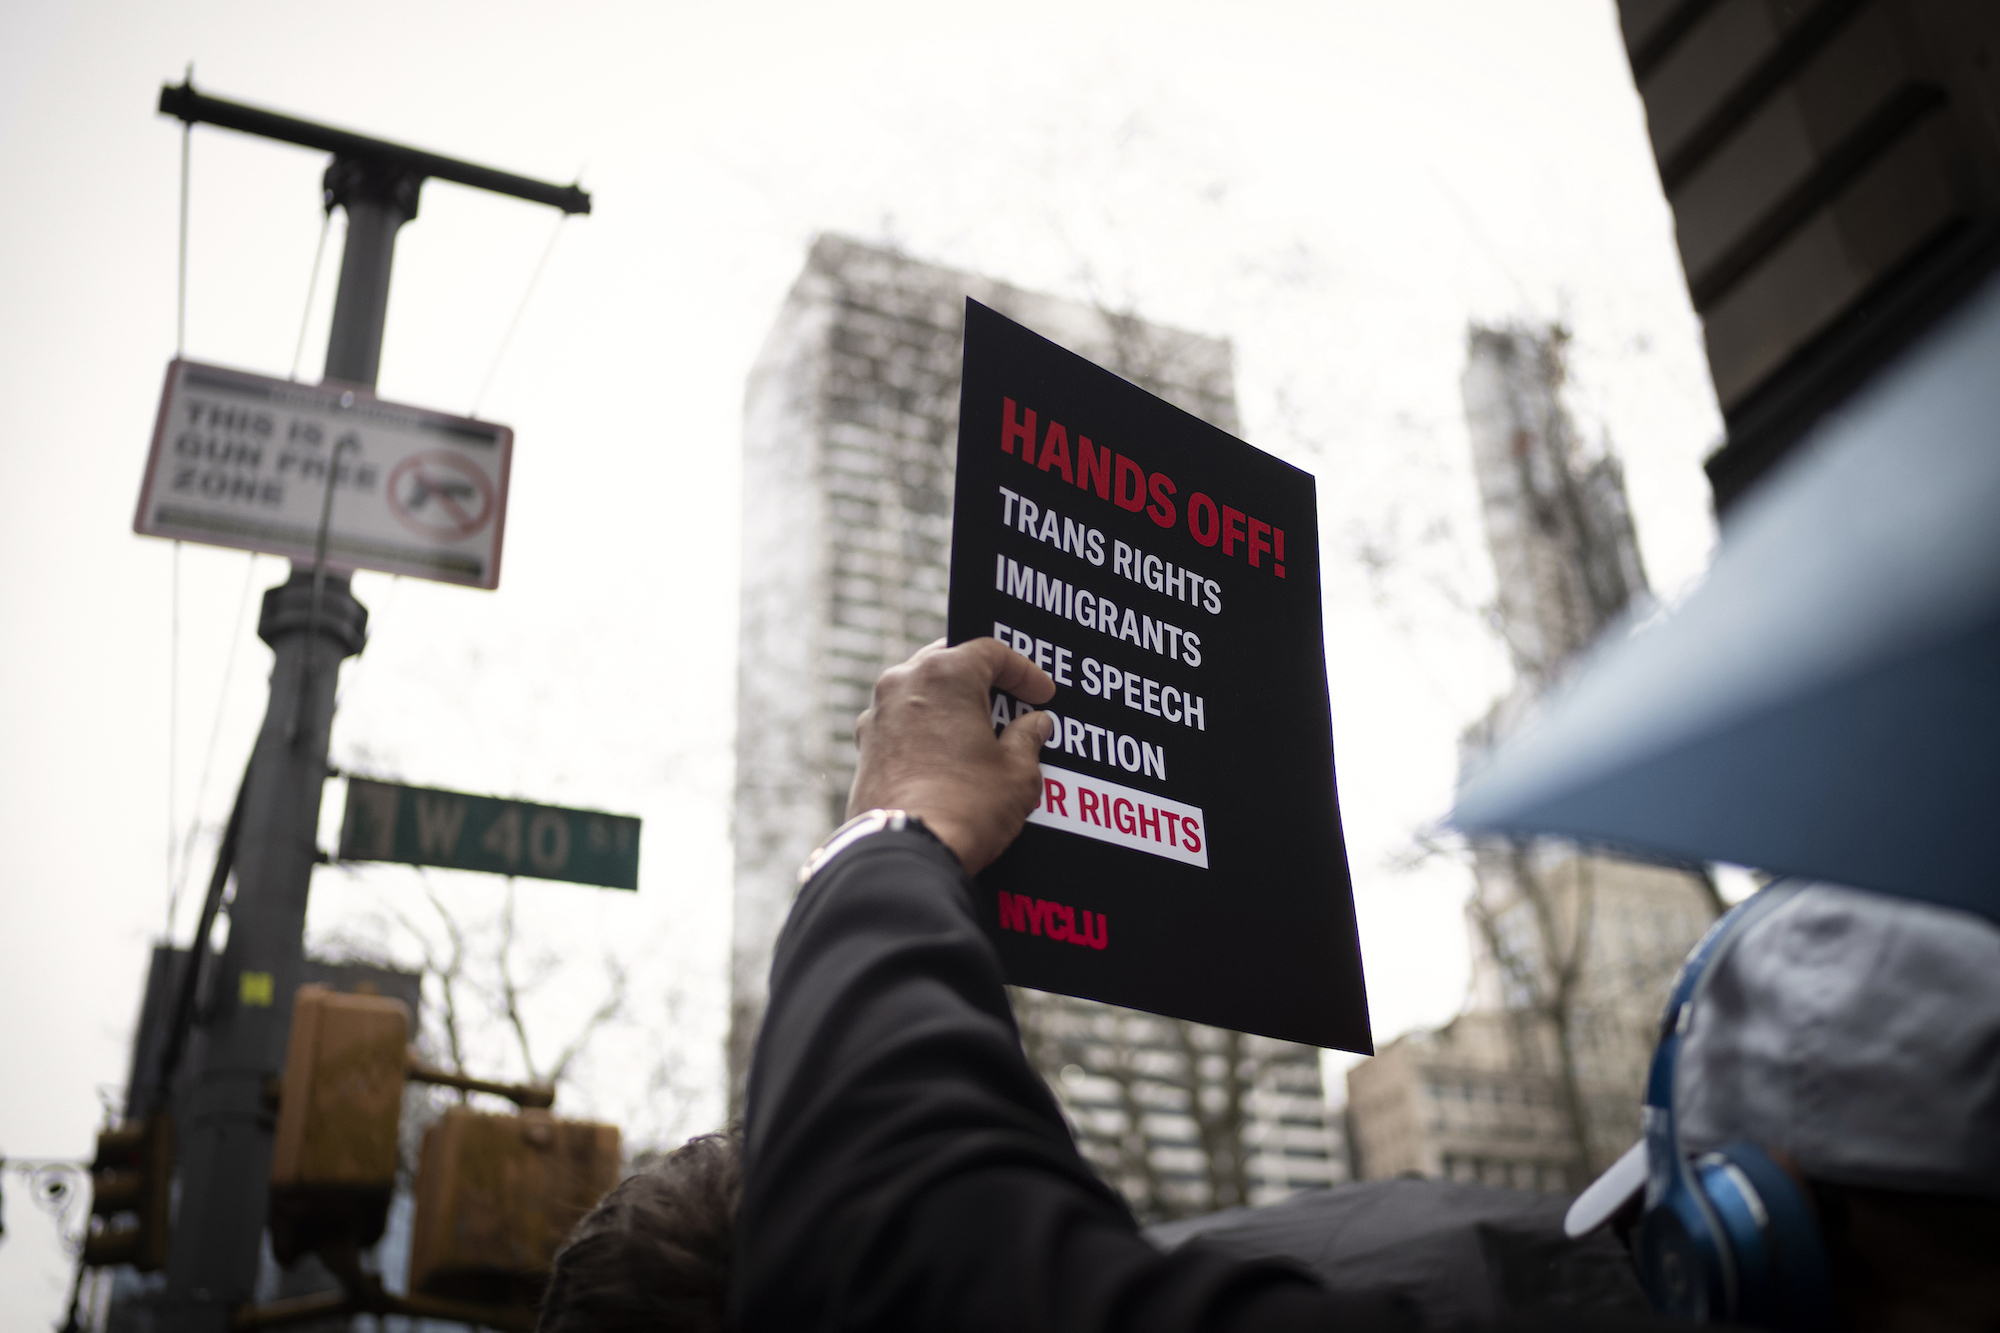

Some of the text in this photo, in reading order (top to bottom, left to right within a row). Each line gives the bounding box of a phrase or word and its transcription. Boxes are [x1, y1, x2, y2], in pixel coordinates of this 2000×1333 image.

[175, 433, 264, 472] GUN
[184, 397, 277, 438] THIS
[288, 419, 327, 447] IS
[172, 464, 284, 507] ZONE
[1001, 396, 1286, 579] HANDS OFF!
[999, 485, 1222, 615] TRANS RIGHTS
[995, 553, 1202, 668] IMMIGRANTS
[1080, 656, 1206, 732] SPEECH
[413, 791, 468, 859] W
[480, 803, 572, 874] 40
[1077, 786, 1202, 854] RIGHTS
[998, 890, 1109, 951] NYCLU
